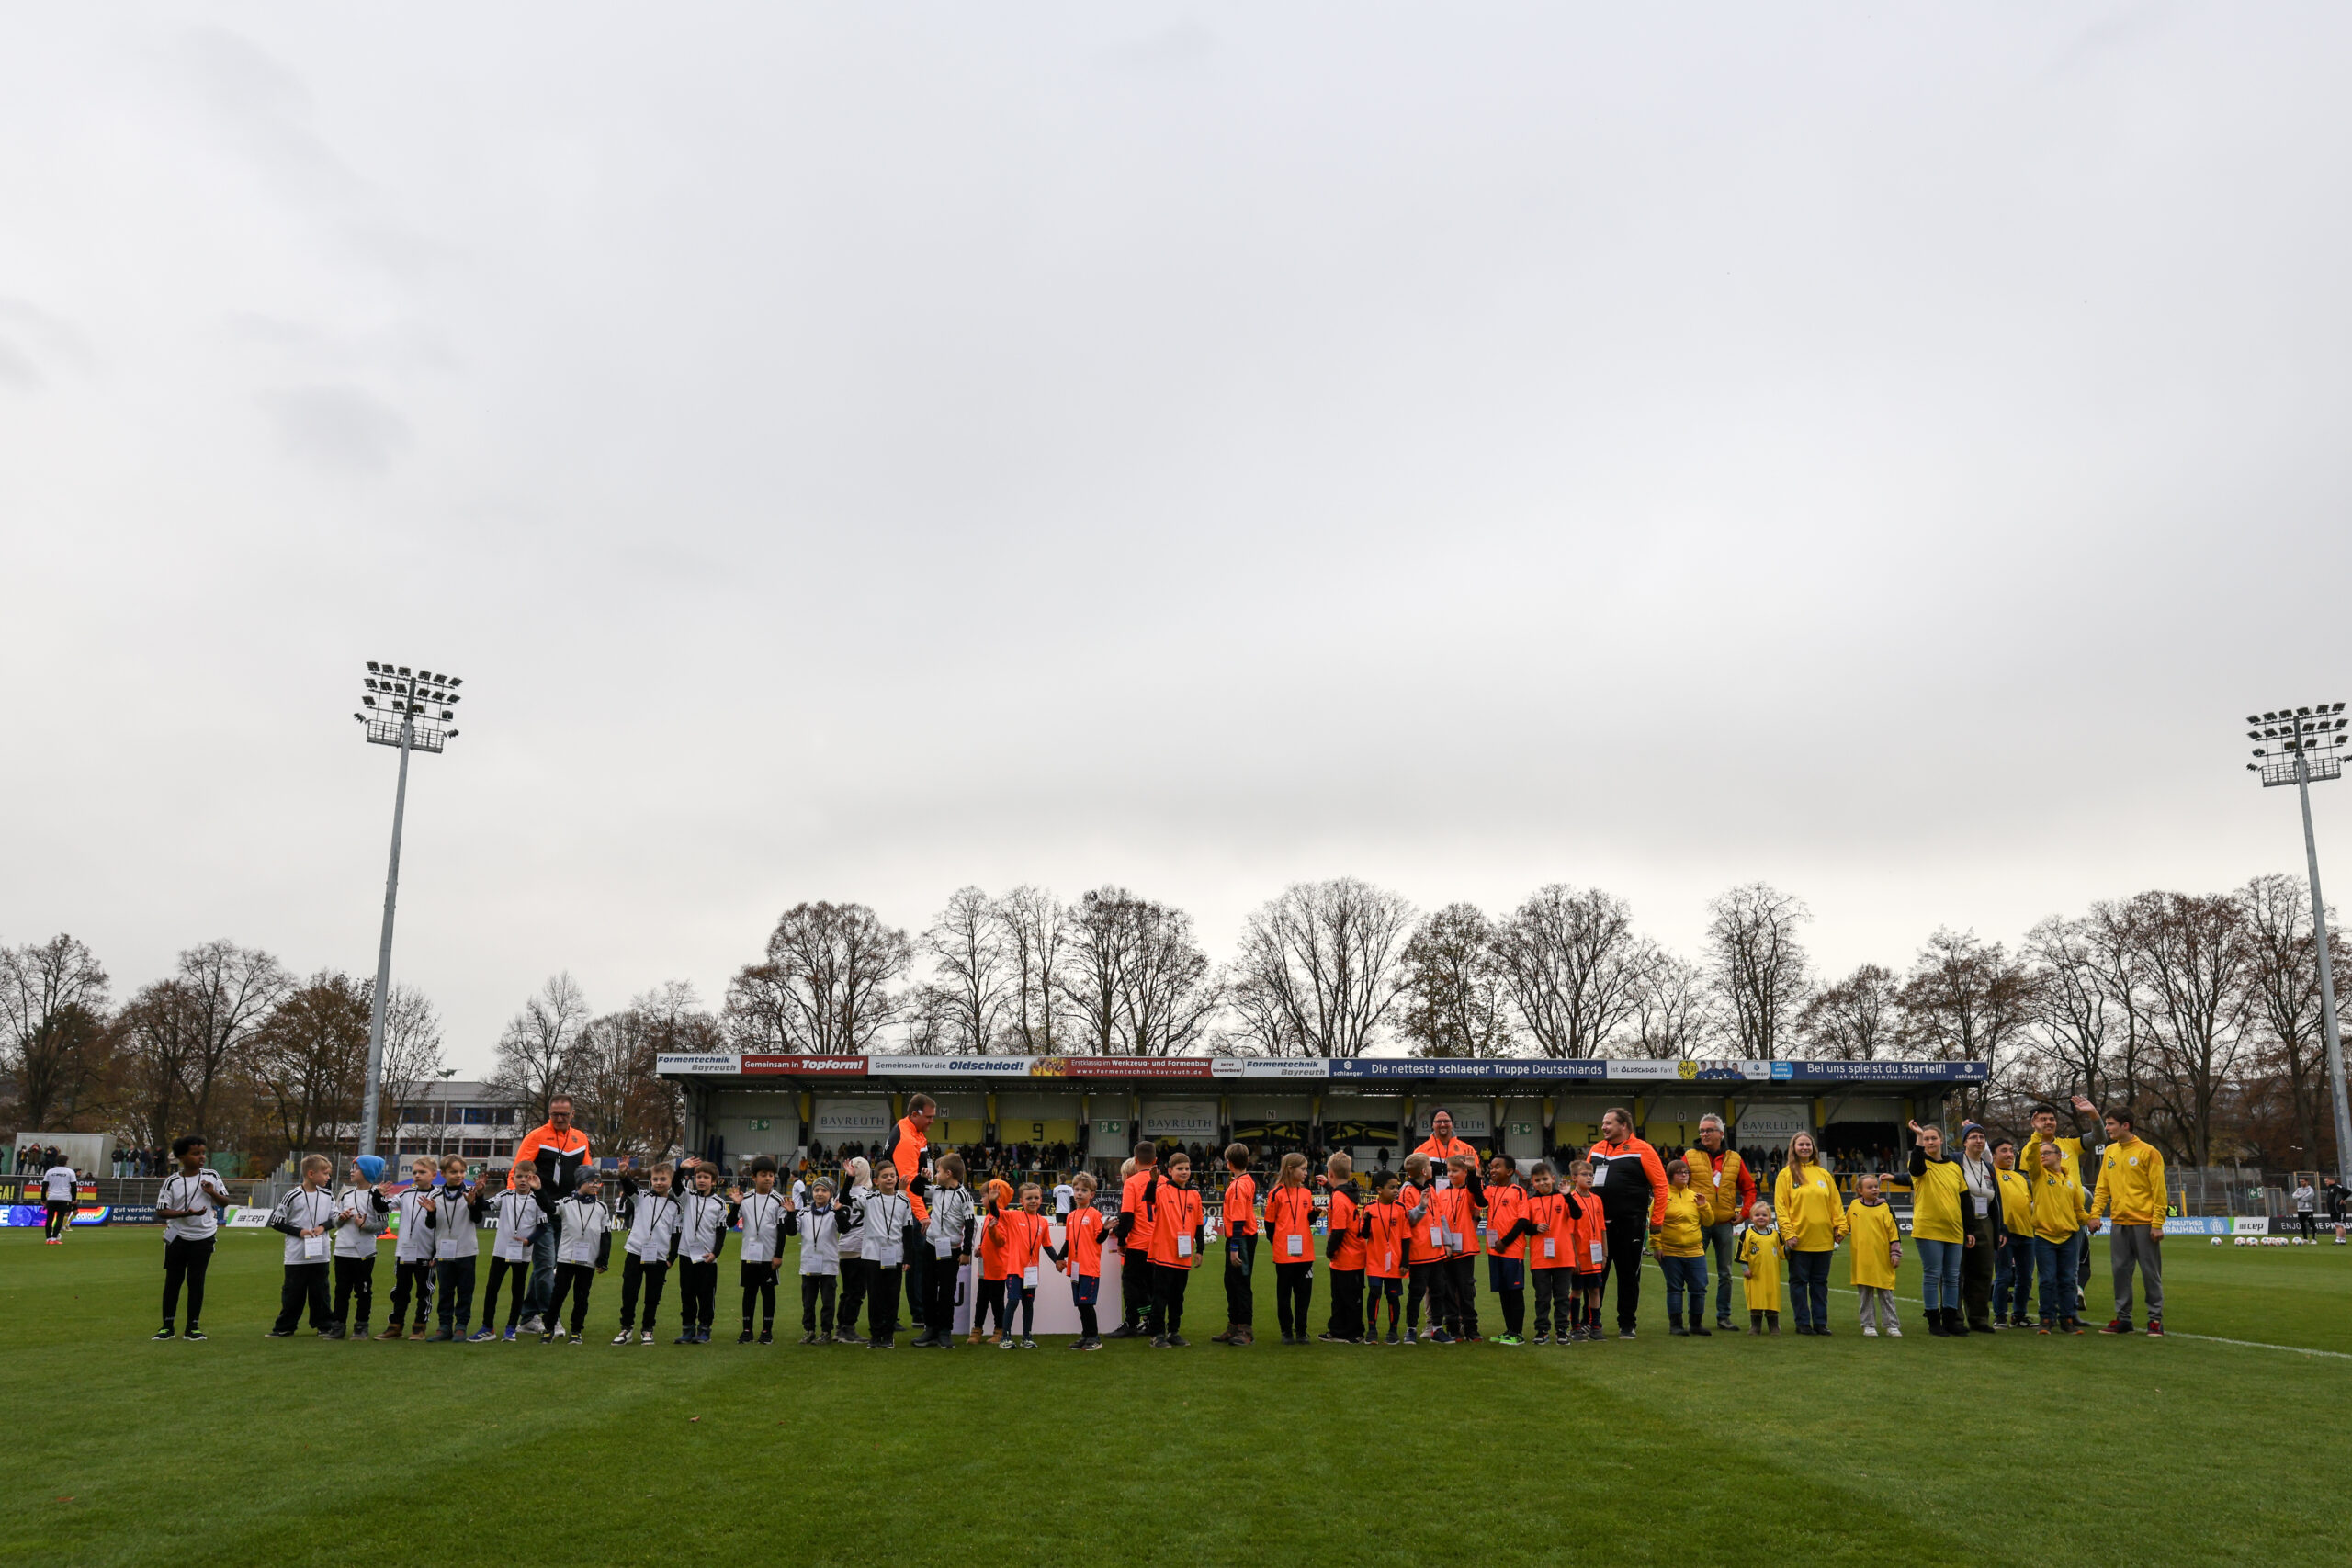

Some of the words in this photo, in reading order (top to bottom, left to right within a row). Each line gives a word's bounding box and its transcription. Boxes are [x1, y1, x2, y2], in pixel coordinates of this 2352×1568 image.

[744, 1060, 789, 1068] Gemeinsam
[801, 1059, 865, 1070] Topform!
[948, 1061, 1024, 1071] Oldschdod!
[1111, 1059, 1150, 1067] Werkzeug-
[1246, 1060, 1319, 1068] Formentechnik
[692, 1064, 737, 1072] Bayreuth
[1281, 1068, 1326, 1077] Bayreuth
[1372, 1064, 1389, 1074] Die
[1391, 1065, 1435, 1074] netteste
[1438, 1065, 1490, 1076] schlaeger
[1493, 1064, 1530, 1076] Truppe
[1532, 1065, 1603, 1075] Deutschlands
[1807, 1064, 1824, 1073] Bei
[1849, 1064, 1883, 1075] spielst
[1885, 1064, 1898, 1073] du
[1901, 1064, 1946, 1074] Startelf!
[940, 1109, 948, 1117] M
[1267, 1110, 1275, 1119] N
[820, 1116, 885, 1127] BAYREUTH
[1148, 1119, 1212, 1129] BAYREUTH
[1742, 1121, 1804, 1131] BAYREUTH
[2097, 1145, 2104, 1154] P
[2247, 1223, 2264, 1231] cep
[2281, 1222, 2301, 1230] ENJO
